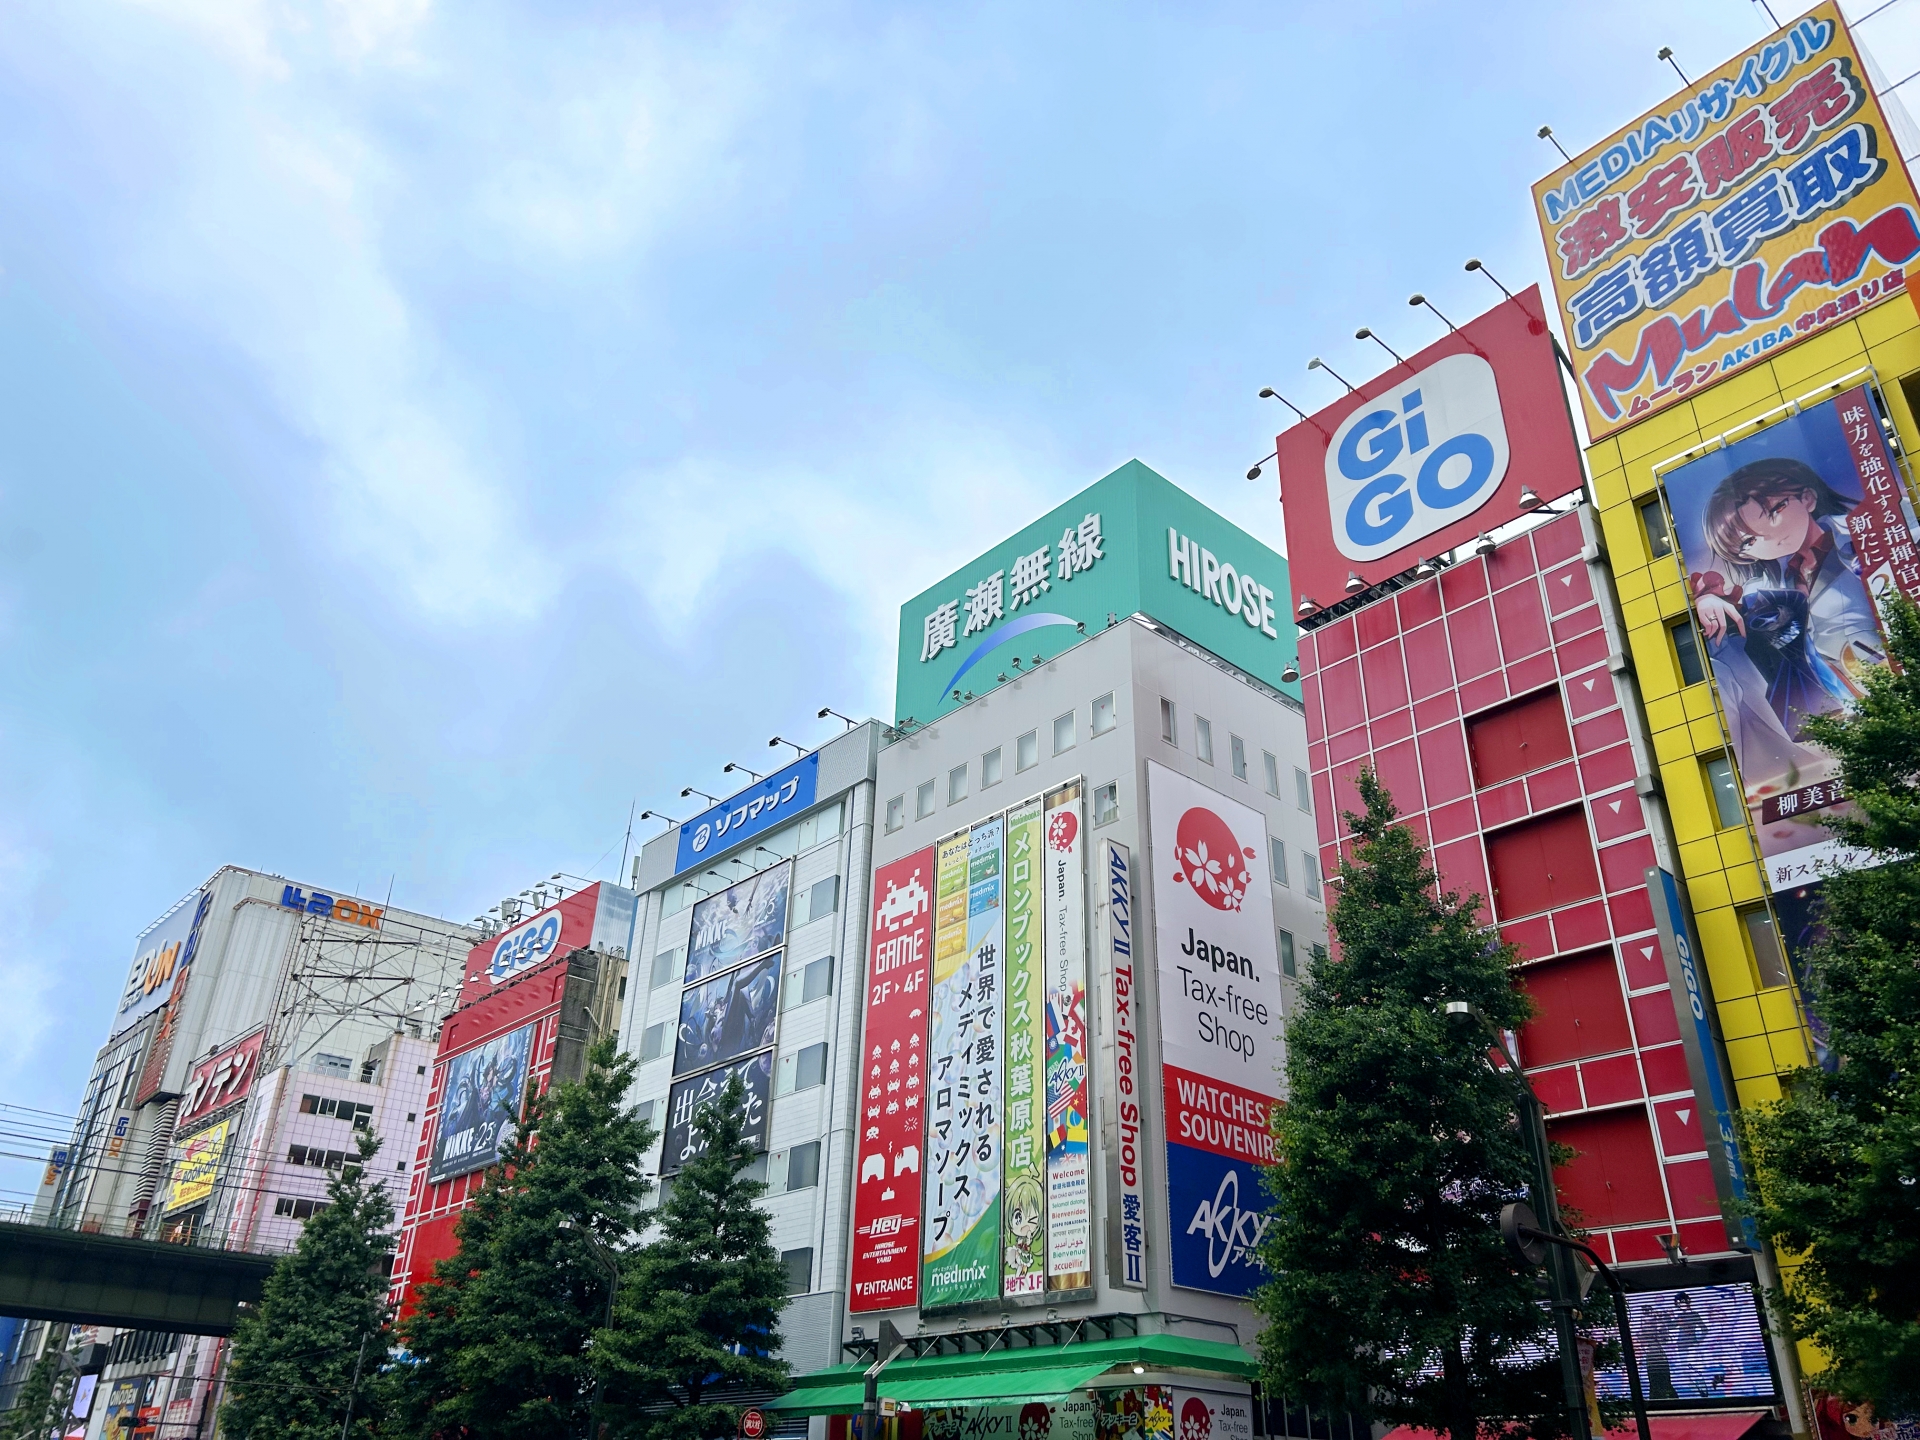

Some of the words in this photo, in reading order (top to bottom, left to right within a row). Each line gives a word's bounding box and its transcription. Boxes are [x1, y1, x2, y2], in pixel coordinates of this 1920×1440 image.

[1559, 60, 1858, 277] 激安販売
[1568, 125, 1884, 348] 高額買取
[1627, 362, 1719, 418] ムーラン
[1721, 325, 1794, 372] AKIBA
[1796, 268, 1904, 333] 中央通り店
[1346, 433, 1495, 547] GO
[1842, 404, 1920, 609] 味方を強化する指揮官
[919, 512, 1104, 663] 廣瀬無線
[1167, 526, 1278, 640] HIROSE
[715, 775, 799, 838] ソフマップ
[1057, 859, 1067, 902] Japan.
[1110, 846, 1130, 939] AKKY
[875, 928, 924, 975] GAME
[1057, 905, 1068, 956] Tax-free
[1181, 927, 1260, 982] Japan.
[872, 981, 892, 1006] 2F
[903, 969, 925, 994] 4F
[1009, 830, 1035, 1170] メロンブックス秋葉原店
[1058, 958, 1068, 993] Shop
[1177, 965, 1268, 1025] Tax-free
[975, 943, 996, 1162] 世界で愛される
[1115, 964, 1136, 1095] Tax-free
[1198, 1011, 1255, 1063] Shop
[179, 1041, 254, 1118] オノデン
[954, 982, 974, 1200] メディミックス
[1177, 1077, 1265, 1128] WATCHES
[933, 1054, 954, 1242] アロマソープ
[1120, 1101, 1138, 1188] Shop
[1179, 1110, 1286, 1164] SOUVENIRS
[1052, 1168, 1085, 1180] Welcome
[871, 1215, 902, 1236] Hey
[1052, 1208, 1086, 1219] Bienvenidos
[1187, 1169, 1272, 1279] AKKY
[863, 1246, 907, 1259] ENTERTAINMENT
[875, 1241, 895, 1250] HIROSE
[876, 1256, 892, 1264] YARD
[1053, 1248, 1086, 1258] Bienvenue
[1054, 1259, 1083, 1271] accueillir
[863, 1276, 914, 1296] ENTRANCE
[931, 1261, 986, 1287] medimix
[1059, 1416, 1094, 1428] Tax-free
[1063, 1401, 1093, 1413] Japan.
[1100, 1411, 1137, 1426] アッキー2
[1218, 1420, 1248, 1434] Tax-free
[1221, 1404, 1247, 1418] Japan.
[1072, 1430, 1094, 1440] Shop
